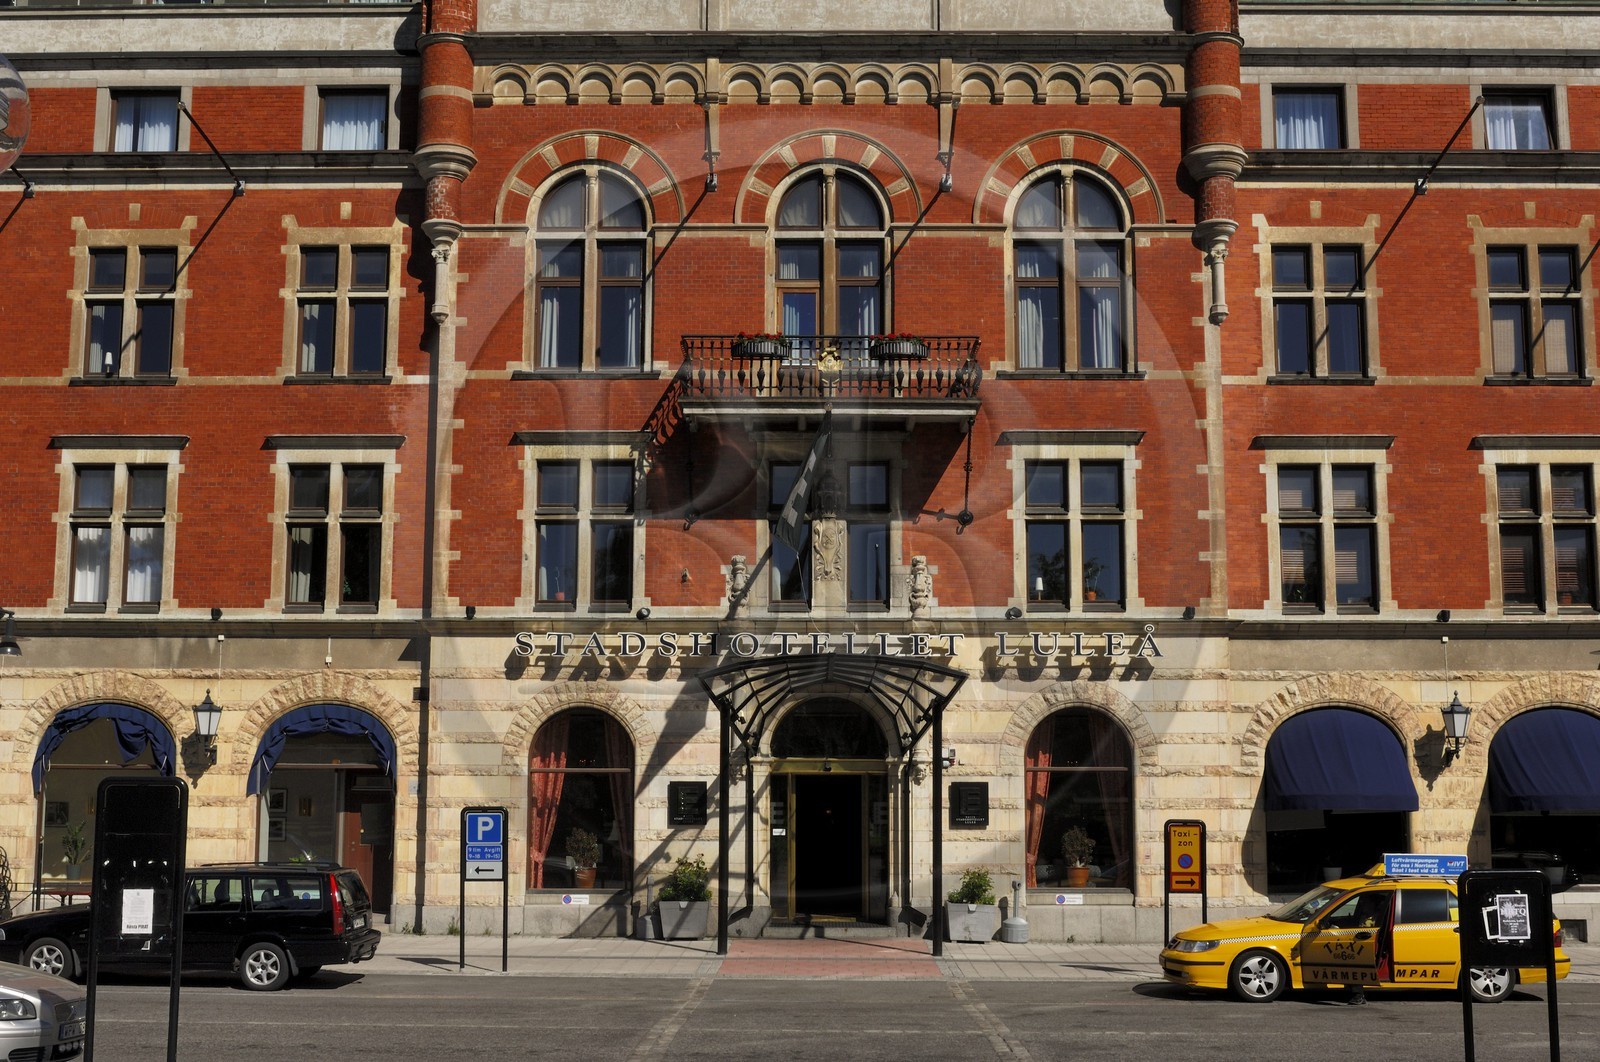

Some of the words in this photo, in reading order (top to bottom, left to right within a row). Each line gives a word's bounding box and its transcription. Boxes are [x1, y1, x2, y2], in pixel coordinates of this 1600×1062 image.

[514, 631, 965, 658] STADSHOTELLET
[994, 623, 1164, 658] LULEÅ
[477, 816, 495, 841] P
[1323, 938, 1365, 956] TAXI
[1396, 969, 1440, 979] MPAR
